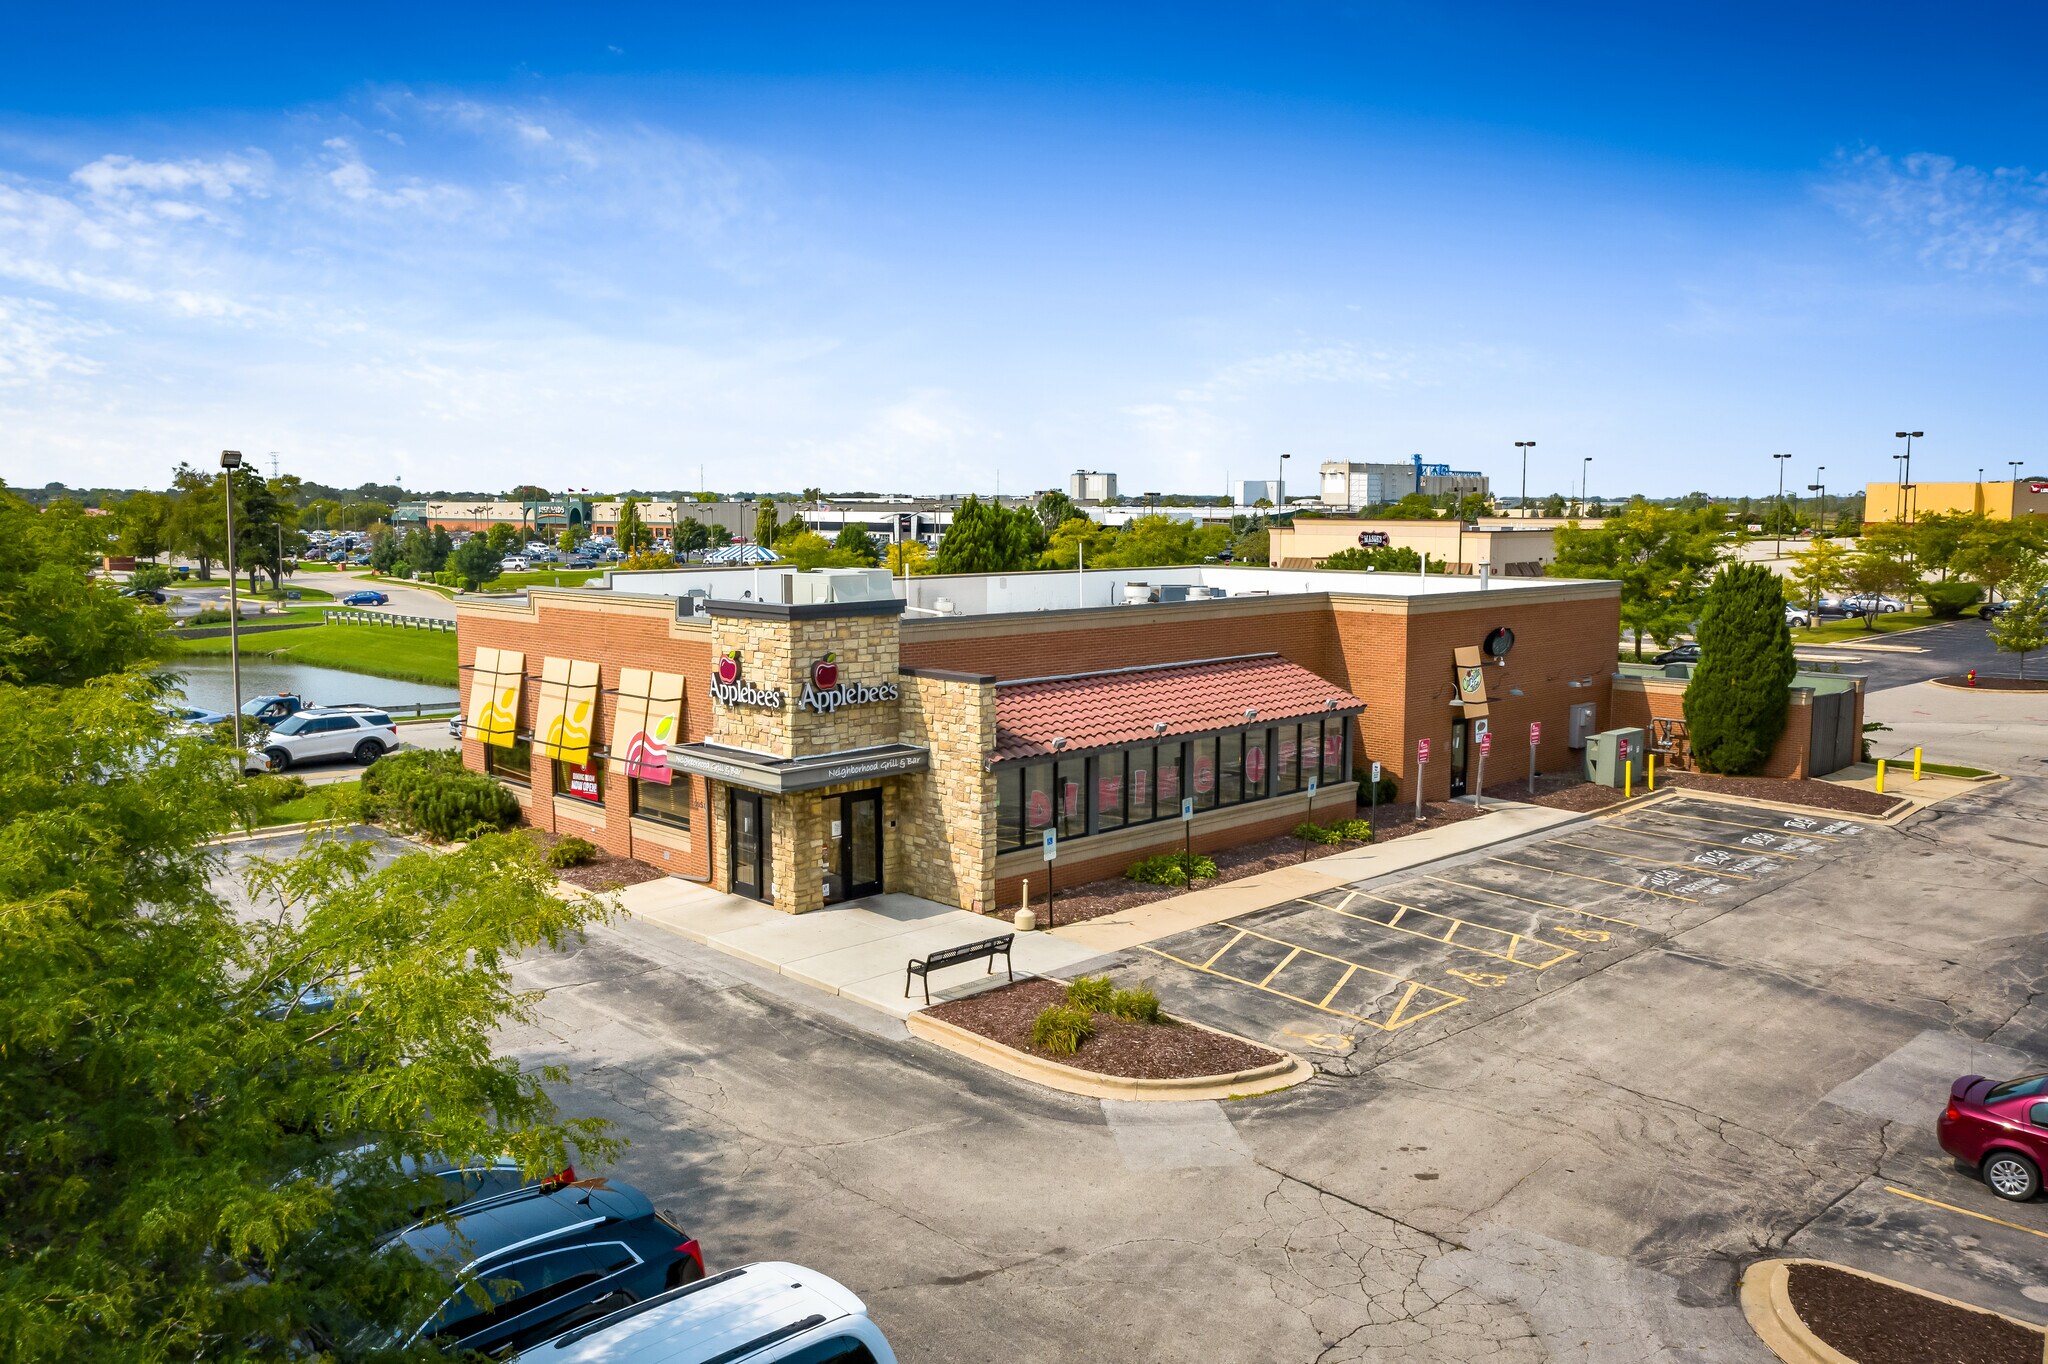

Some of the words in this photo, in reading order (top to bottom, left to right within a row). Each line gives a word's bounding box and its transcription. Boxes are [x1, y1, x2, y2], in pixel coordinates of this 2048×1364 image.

[709, 672, 780, 709] Applebee's
[801, 682, 899, 713] Applebee's
[828, 762, 879, 778] Neighborhood
[880, 758, 899, 770] Grill
[906, 757, 921, 765] Bar
